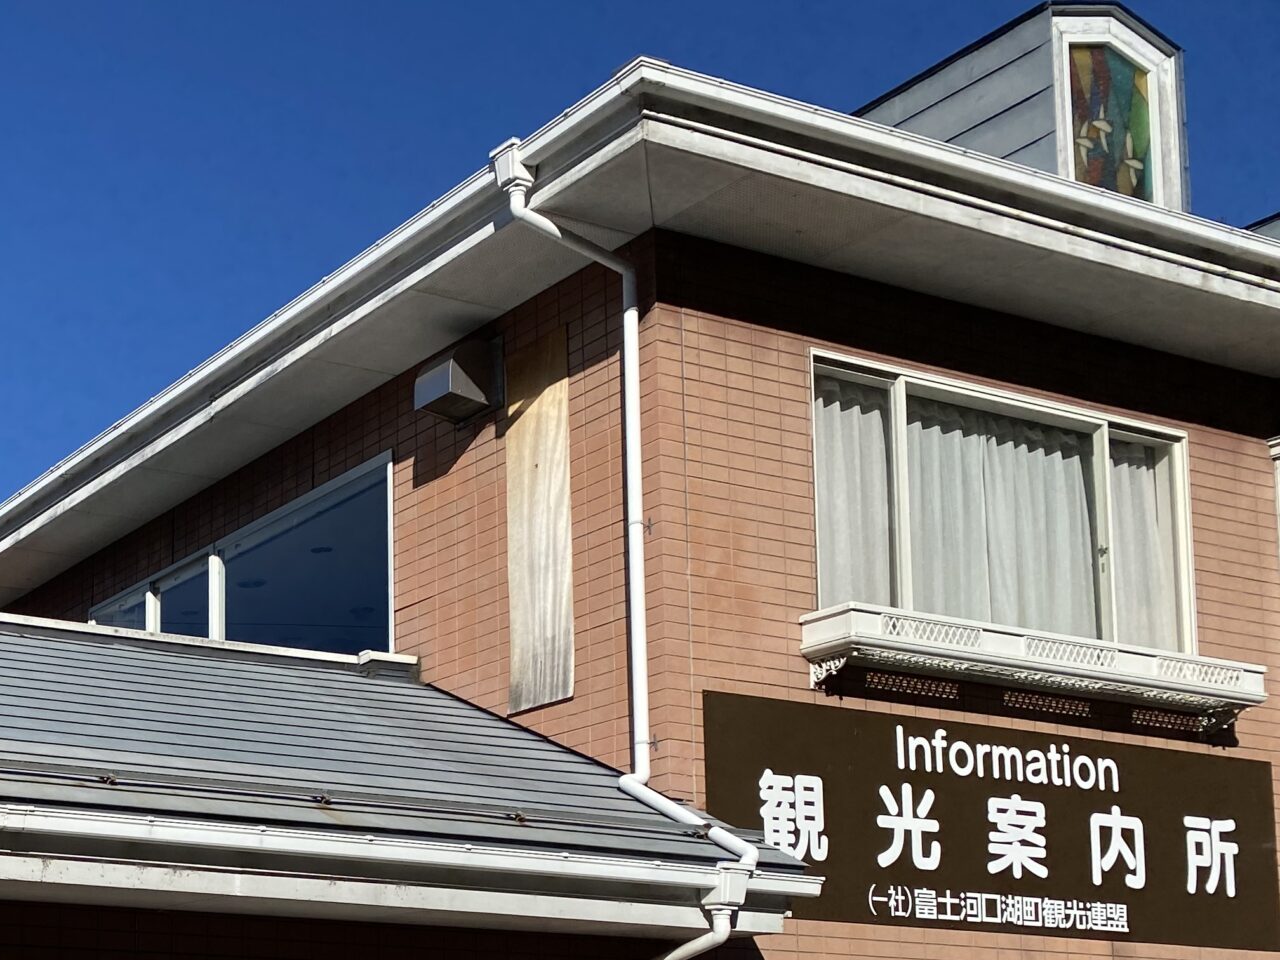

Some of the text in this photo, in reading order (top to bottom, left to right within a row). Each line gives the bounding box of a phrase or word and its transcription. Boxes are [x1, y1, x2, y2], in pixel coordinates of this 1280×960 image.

[895, 724, 1120, 792] Information
[759, 768, 1238, 898] 観光案内所
[868, 884, 1130, 933] (一社)富士河口湖町観光連盟
